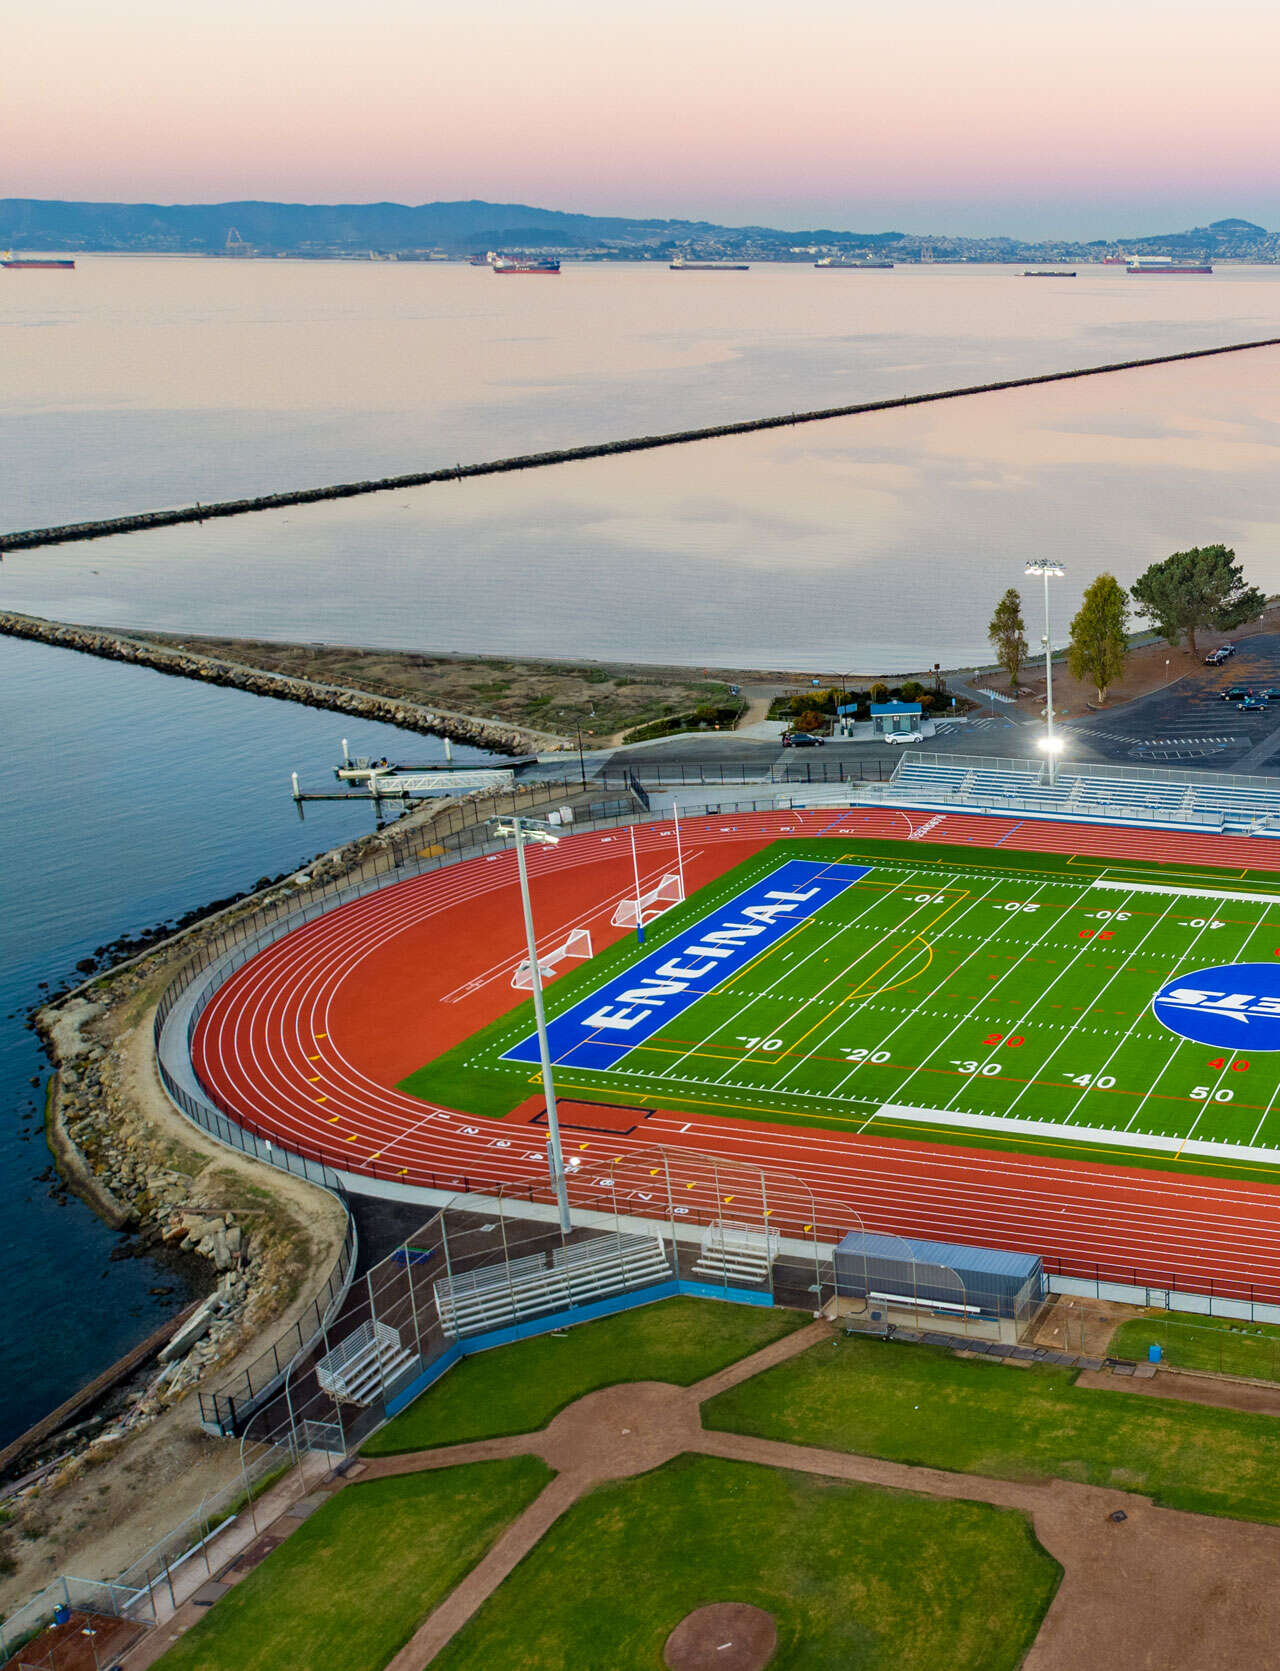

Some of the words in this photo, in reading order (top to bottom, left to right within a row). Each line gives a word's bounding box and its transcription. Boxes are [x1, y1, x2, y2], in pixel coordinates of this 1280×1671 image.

[914, 894, 944, 905] 10
[1003, 902, 1041, 913] 20
[1094, 910, 1132, 922] 30
[1189, 918, 1227, 930] 40
[1079, 929, 1116, 941] 20
[580, 885, 822, 1030] ENCINAL
[745, 1036, 784, 1052] 10
[982, 1033, 1025, 1048] 20
[846, 1047, 892, 1064] 20
[958, 1060, 1002, 1077] 30
[1208, 1057, 1250, 1073] 40
[1072, 1073, 1117, 1090] 40
[1188, 1085, 1235, 1102] 50
[463, 1127, 479, 1135] 2
